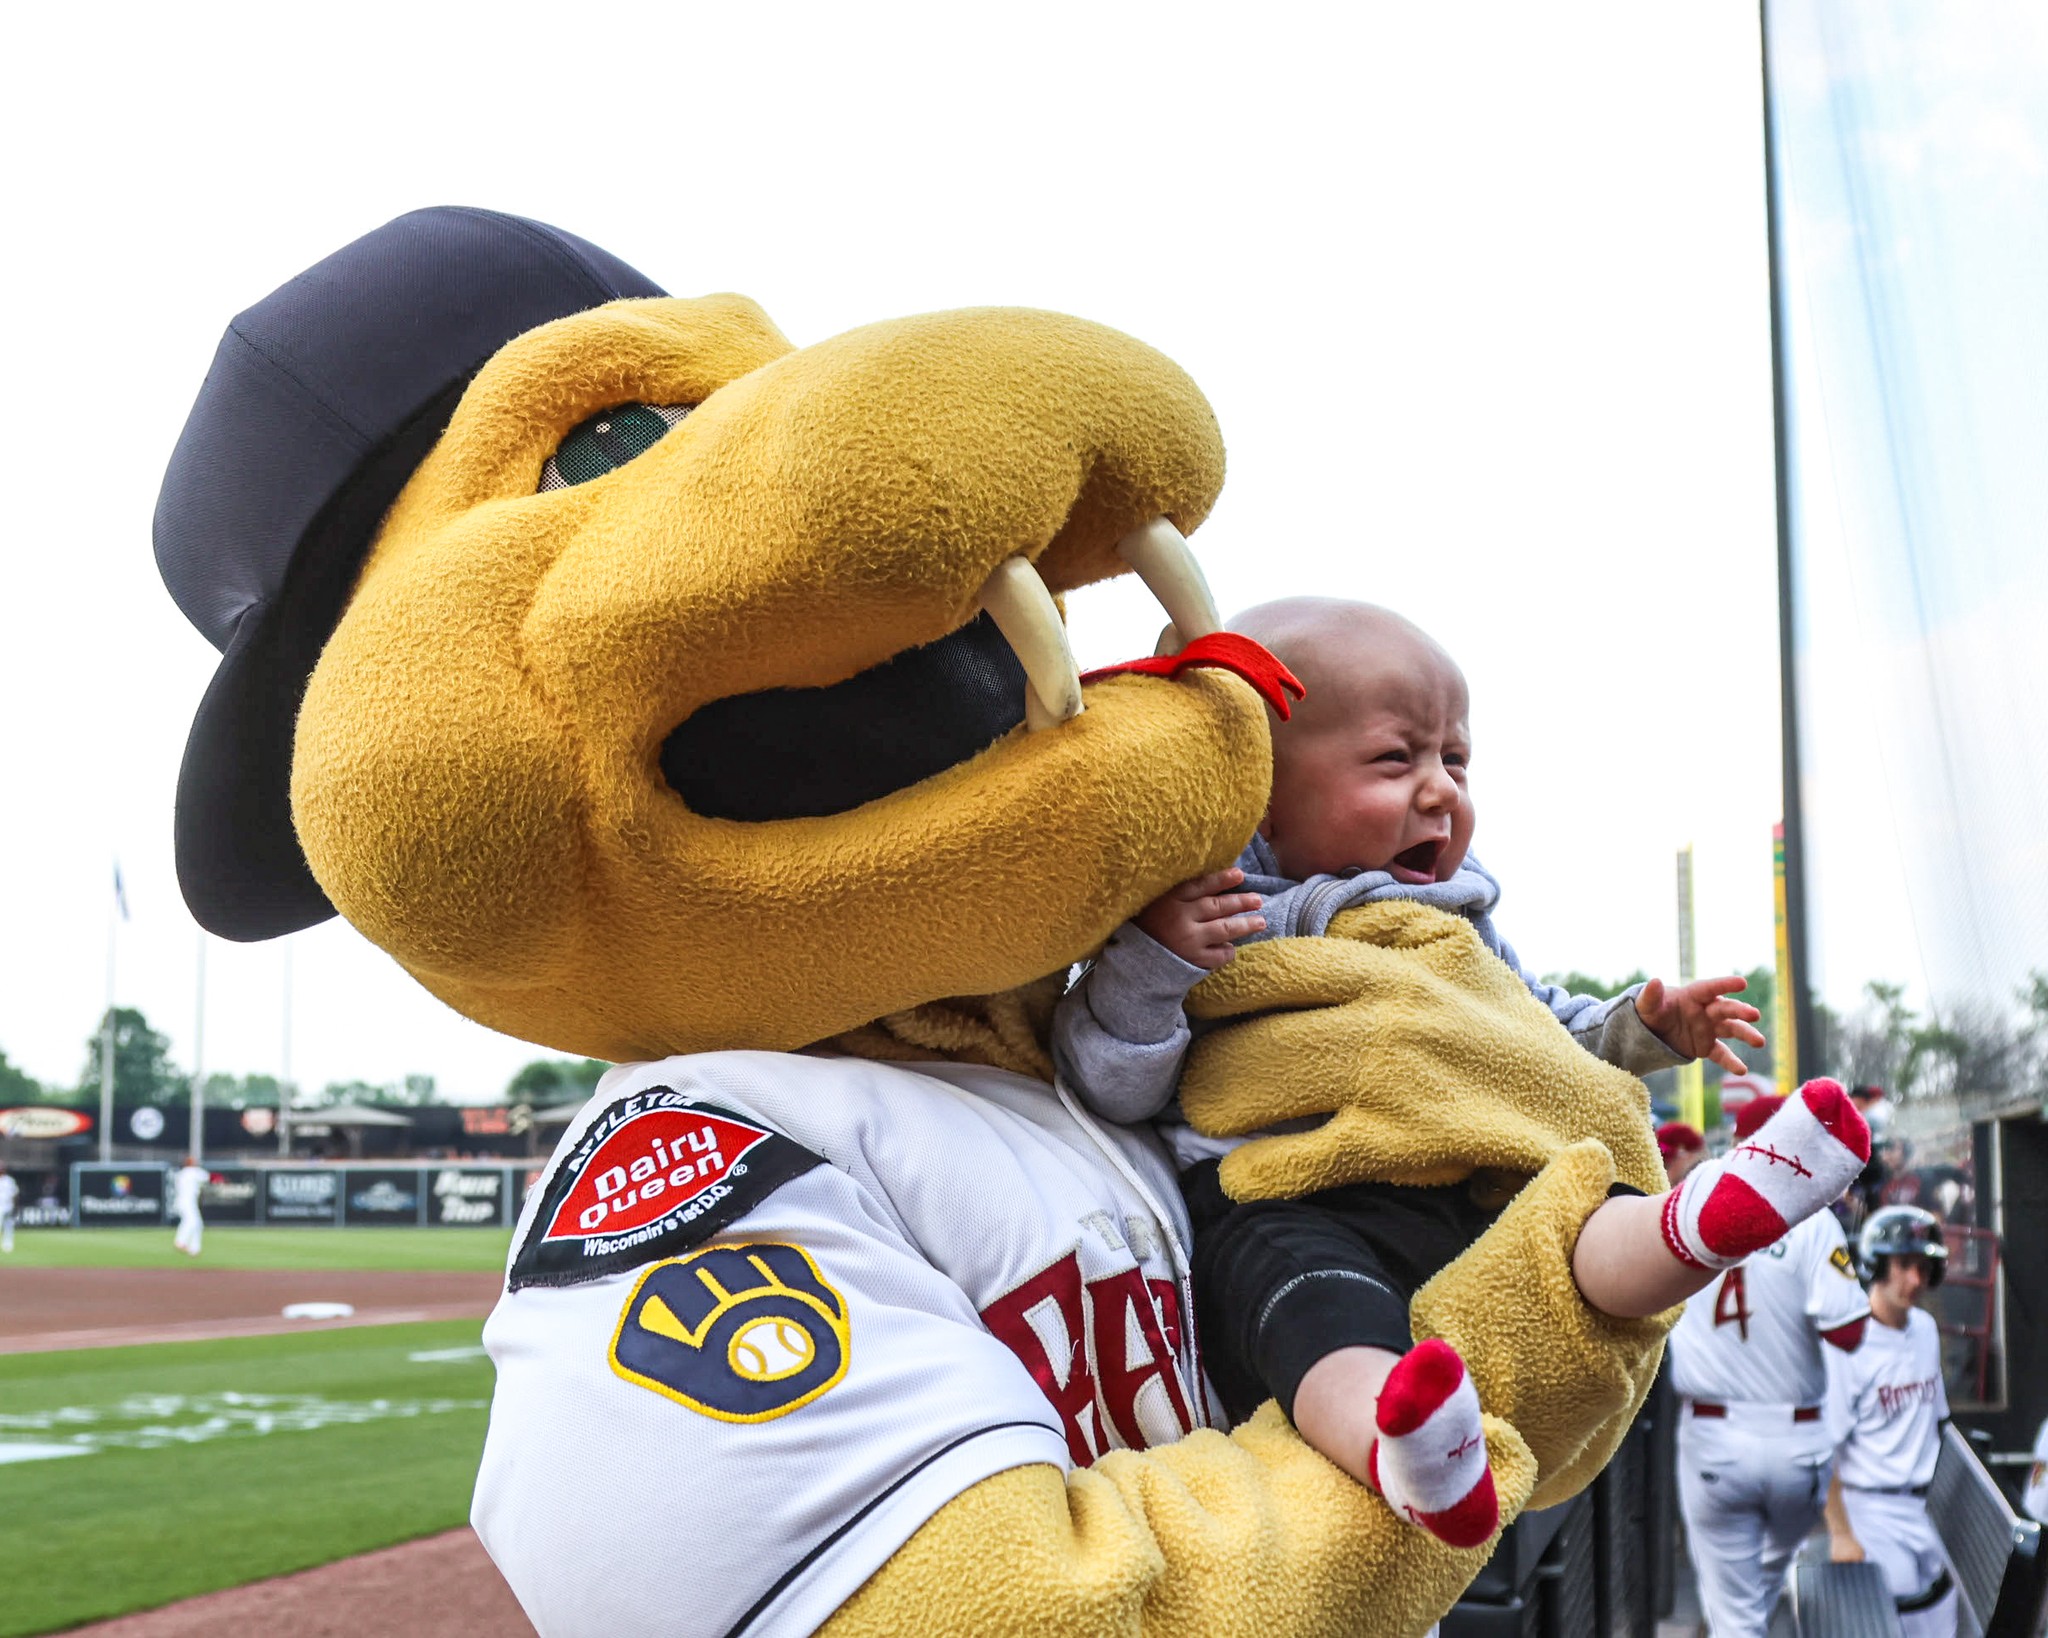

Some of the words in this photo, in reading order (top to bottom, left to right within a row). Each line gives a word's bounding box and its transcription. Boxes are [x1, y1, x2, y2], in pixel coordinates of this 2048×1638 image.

[578, 1152, 725, 1229] Queen
[594, 1125, 719, 1200] Dairy
[582, 1219, 678, 1257] Wisconsin's
[675, 1201, 703, 1226] 1st
[697, 1184, 734, 1214] D.Q.
[1714, 1266, 1753, 1343] 4
